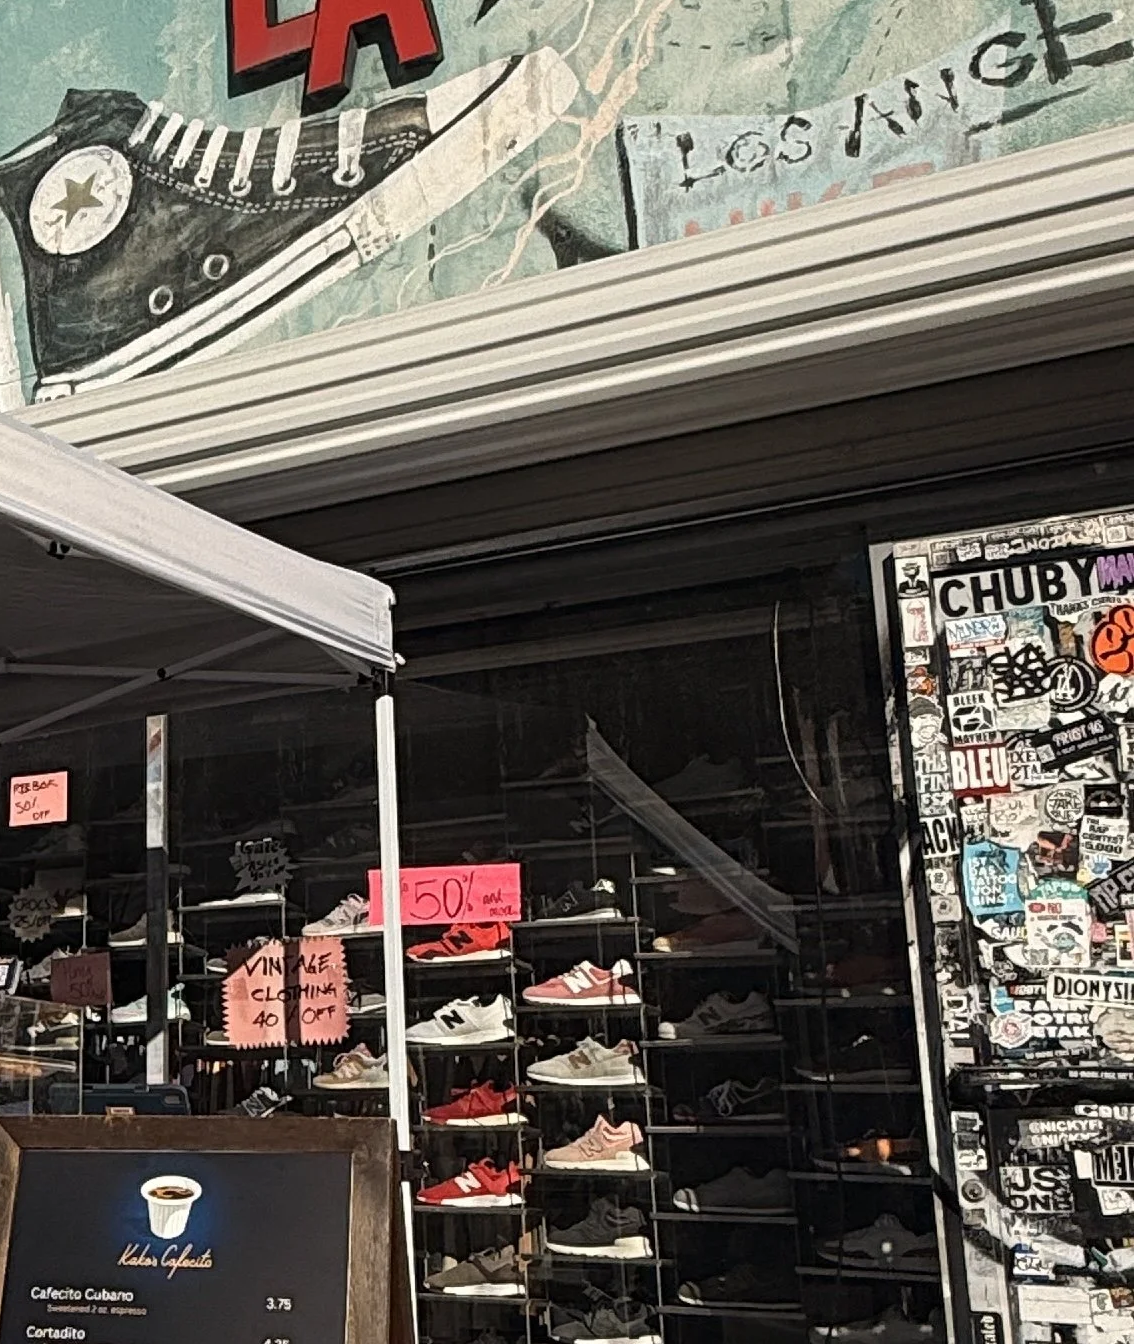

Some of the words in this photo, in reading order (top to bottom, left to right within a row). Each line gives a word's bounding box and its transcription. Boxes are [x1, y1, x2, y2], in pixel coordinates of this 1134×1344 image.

[939, 558, 1096, 617] CHUBY
[950, 747, 1007, 790] BLEU
[251, 982, 337, 1004] CLOTHING
[301, 1006, 337, 1025] OFF
[30, 1286, 82, 1300] Cafecito
[84, 1288, 134, 1302] Cubano
[110, 1307, 147, 1317] espresso
[266, 1297, 292, 1310] 3.75
[26, 1325, 86, 1340] Cortadito
